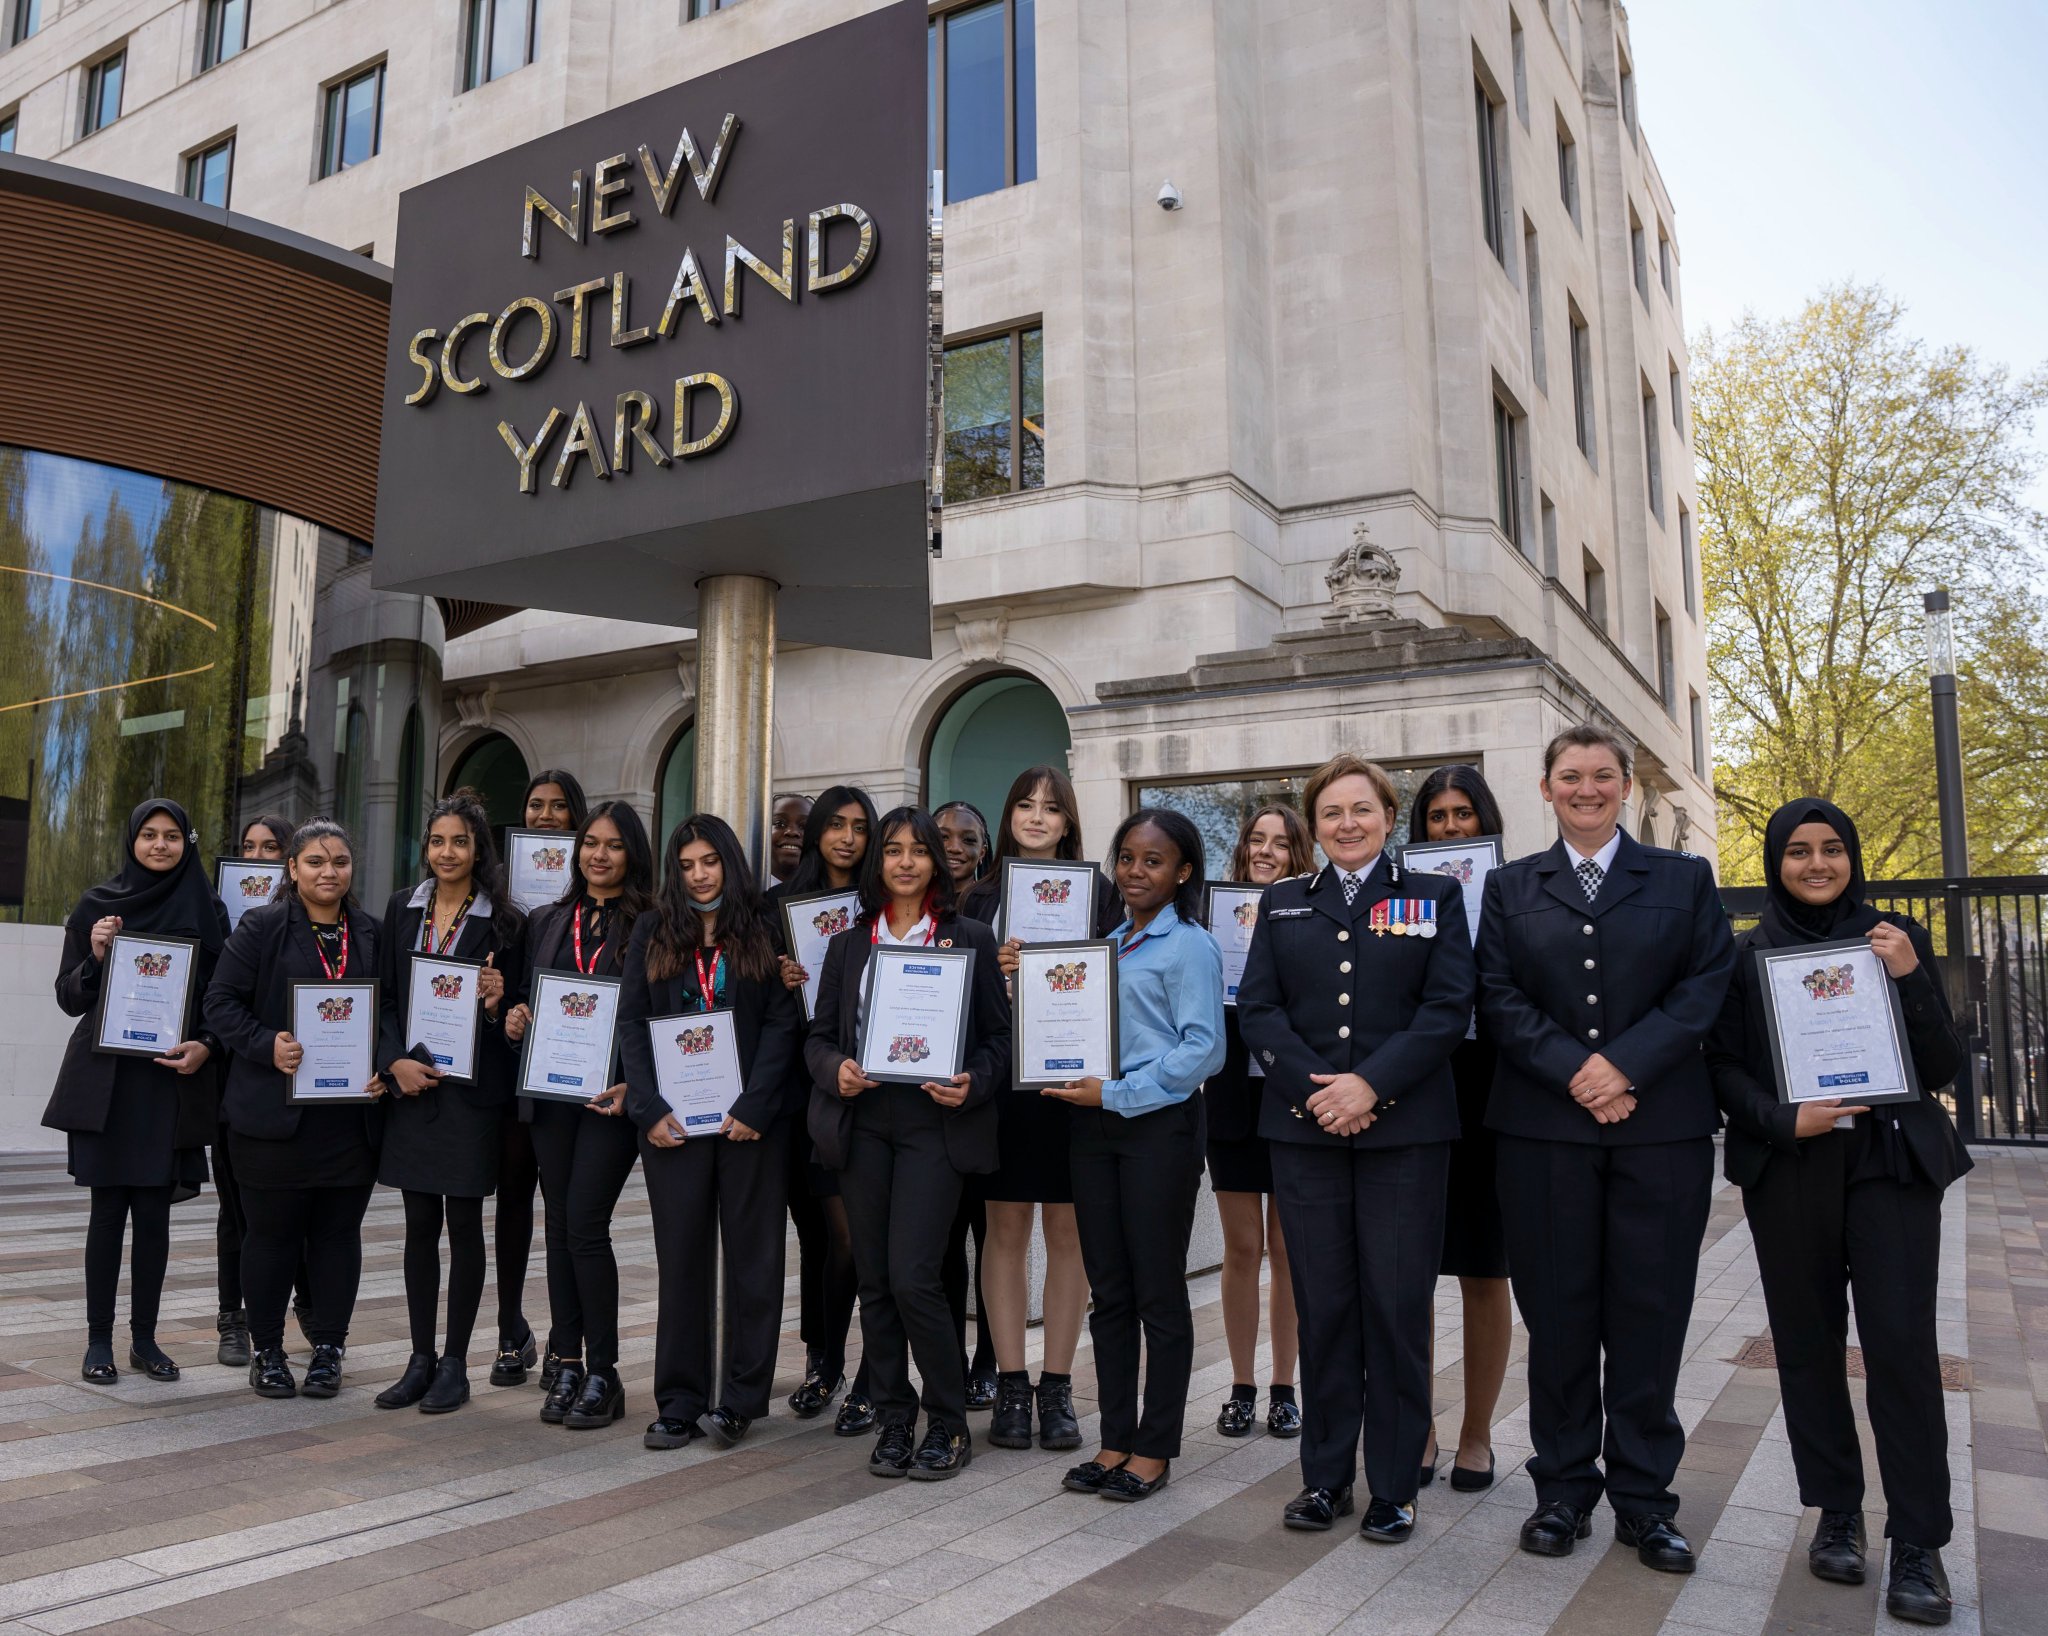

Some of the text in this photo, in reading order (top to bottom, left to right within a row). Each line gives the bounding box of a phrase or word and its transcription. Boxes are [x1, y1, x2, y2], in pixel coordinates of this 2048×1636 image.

[521, 113, 741, 260] NEW
[405, 202, 880, 407] SCOTLAND
[497, 371, 740, 495] YARD
